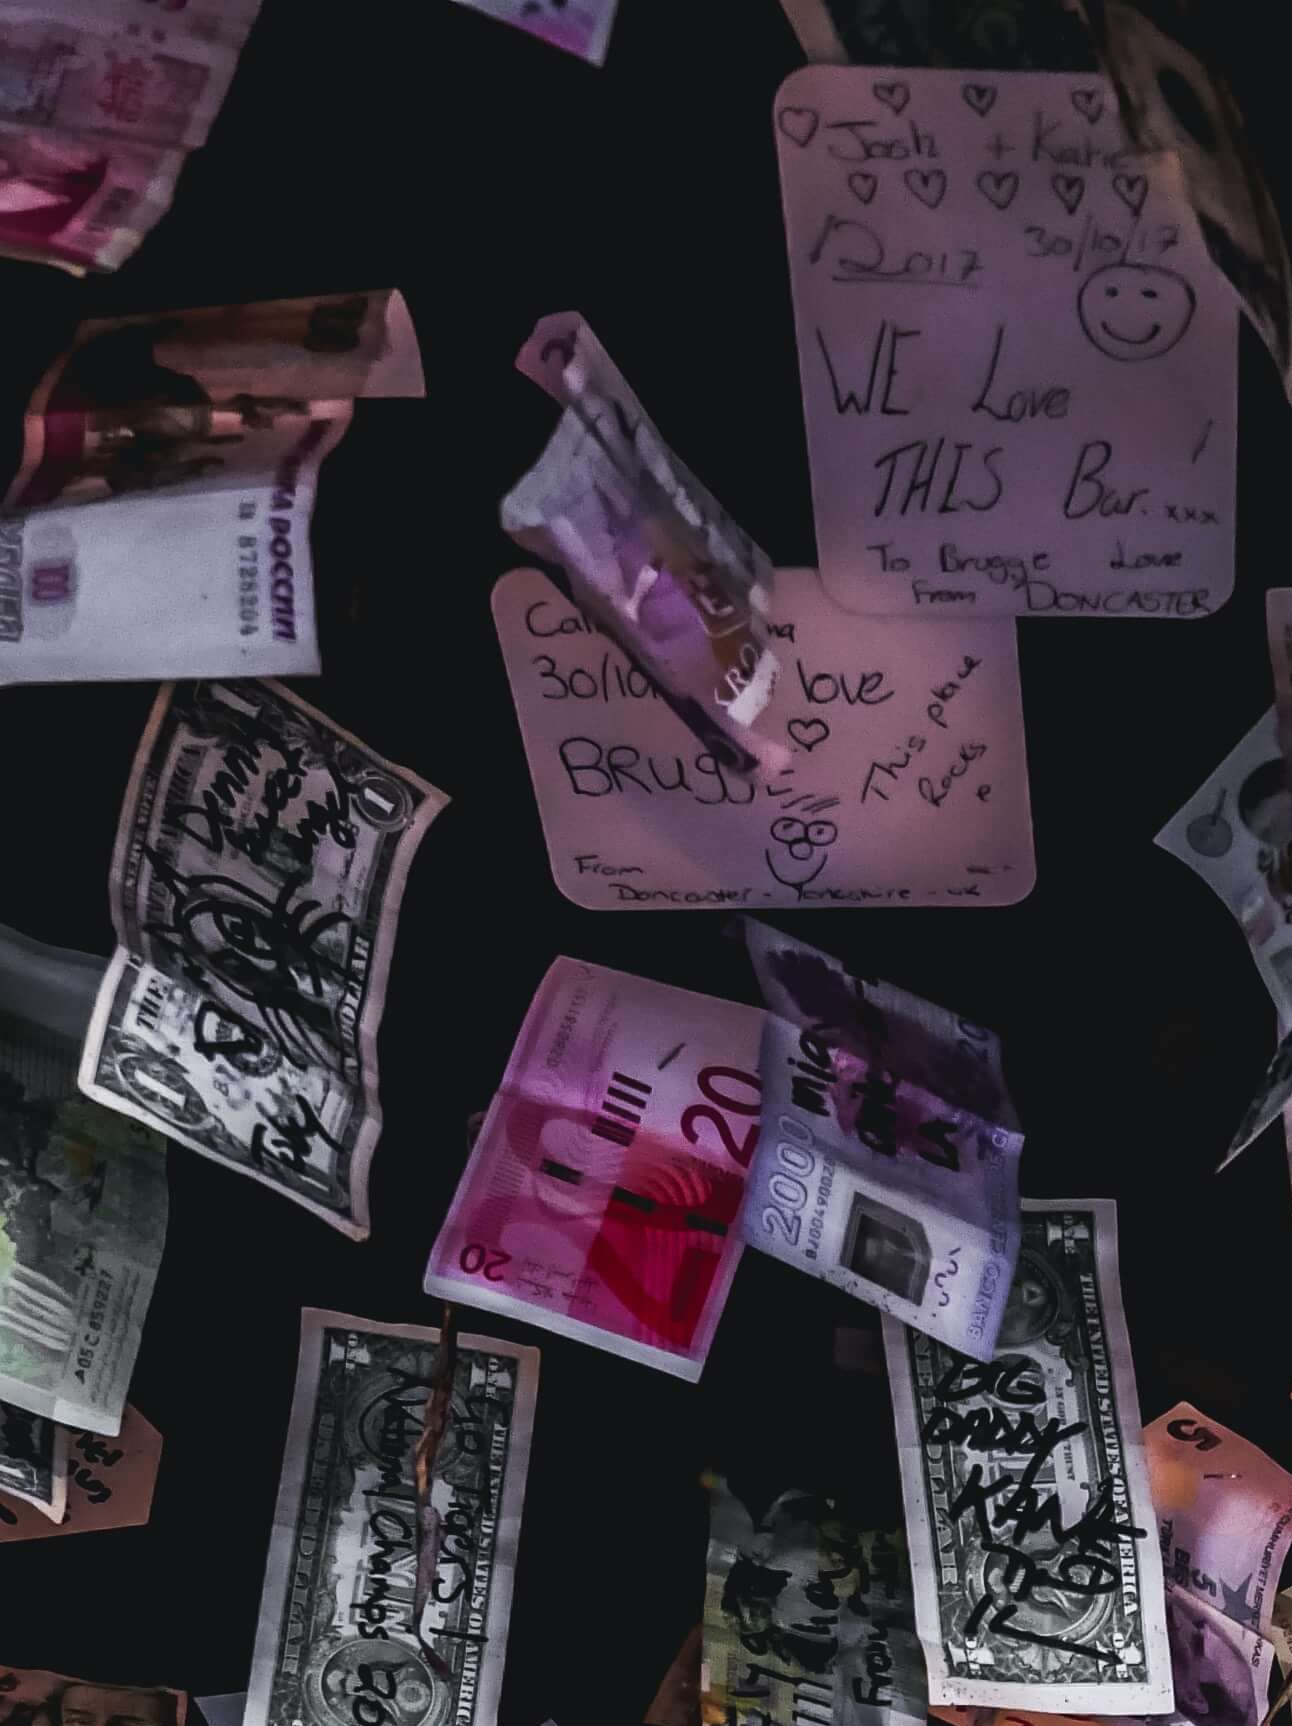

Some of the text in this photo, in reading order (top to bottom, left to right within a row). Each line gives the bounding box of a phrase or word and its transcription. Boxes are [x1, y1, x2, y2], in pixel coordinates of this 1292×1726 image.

[816, 320, 1072, 422] WE Love
[875, 437, 1004, 517] THIS
[868, 543, 910, 572] To
[940, 543, 1051, 588] Brugge
[1016, 578, 1210, 616] DONCASTER
[798, 662, 896, 703] love
[764, 1114, 815, 1246] 2000
[459, 1244, 511, 1282] 20
[1167, 1419, 1221, 1451] 5
